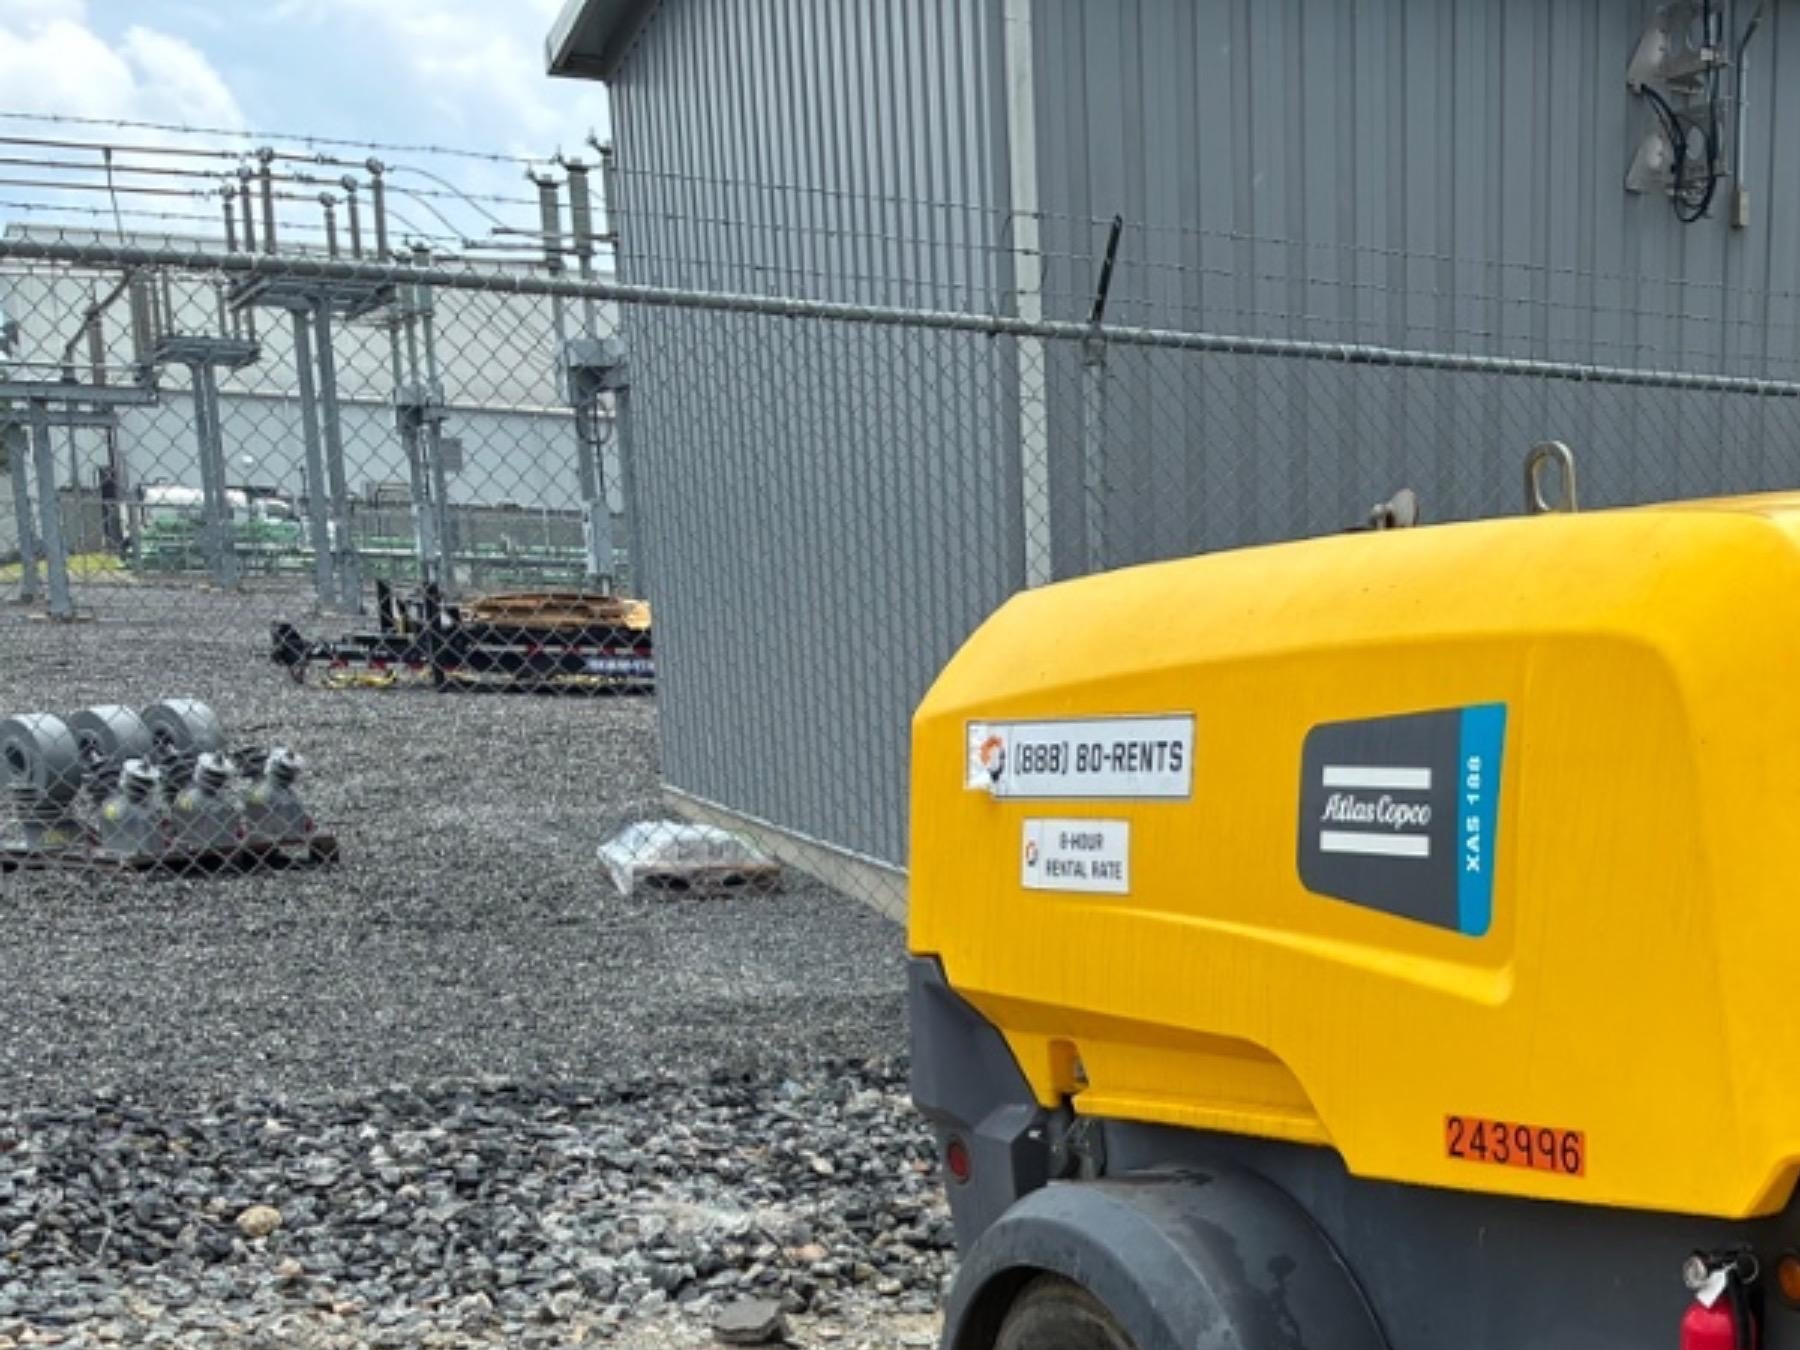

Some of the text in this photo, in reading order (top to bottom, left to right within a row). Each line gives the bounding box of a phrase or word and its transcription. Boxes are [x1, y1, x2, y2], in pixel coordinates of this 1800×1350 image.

[1014, 740, 1183, 775] (888) 80-RENTS
[1321, 792, 1432, 831] Atlas Copco
[1466, 755, 1482, 872] XAS 188
[1046, 858, 1123, 880] RENTAL RATE
[1447, 1115, 1580, 1174] 243996
